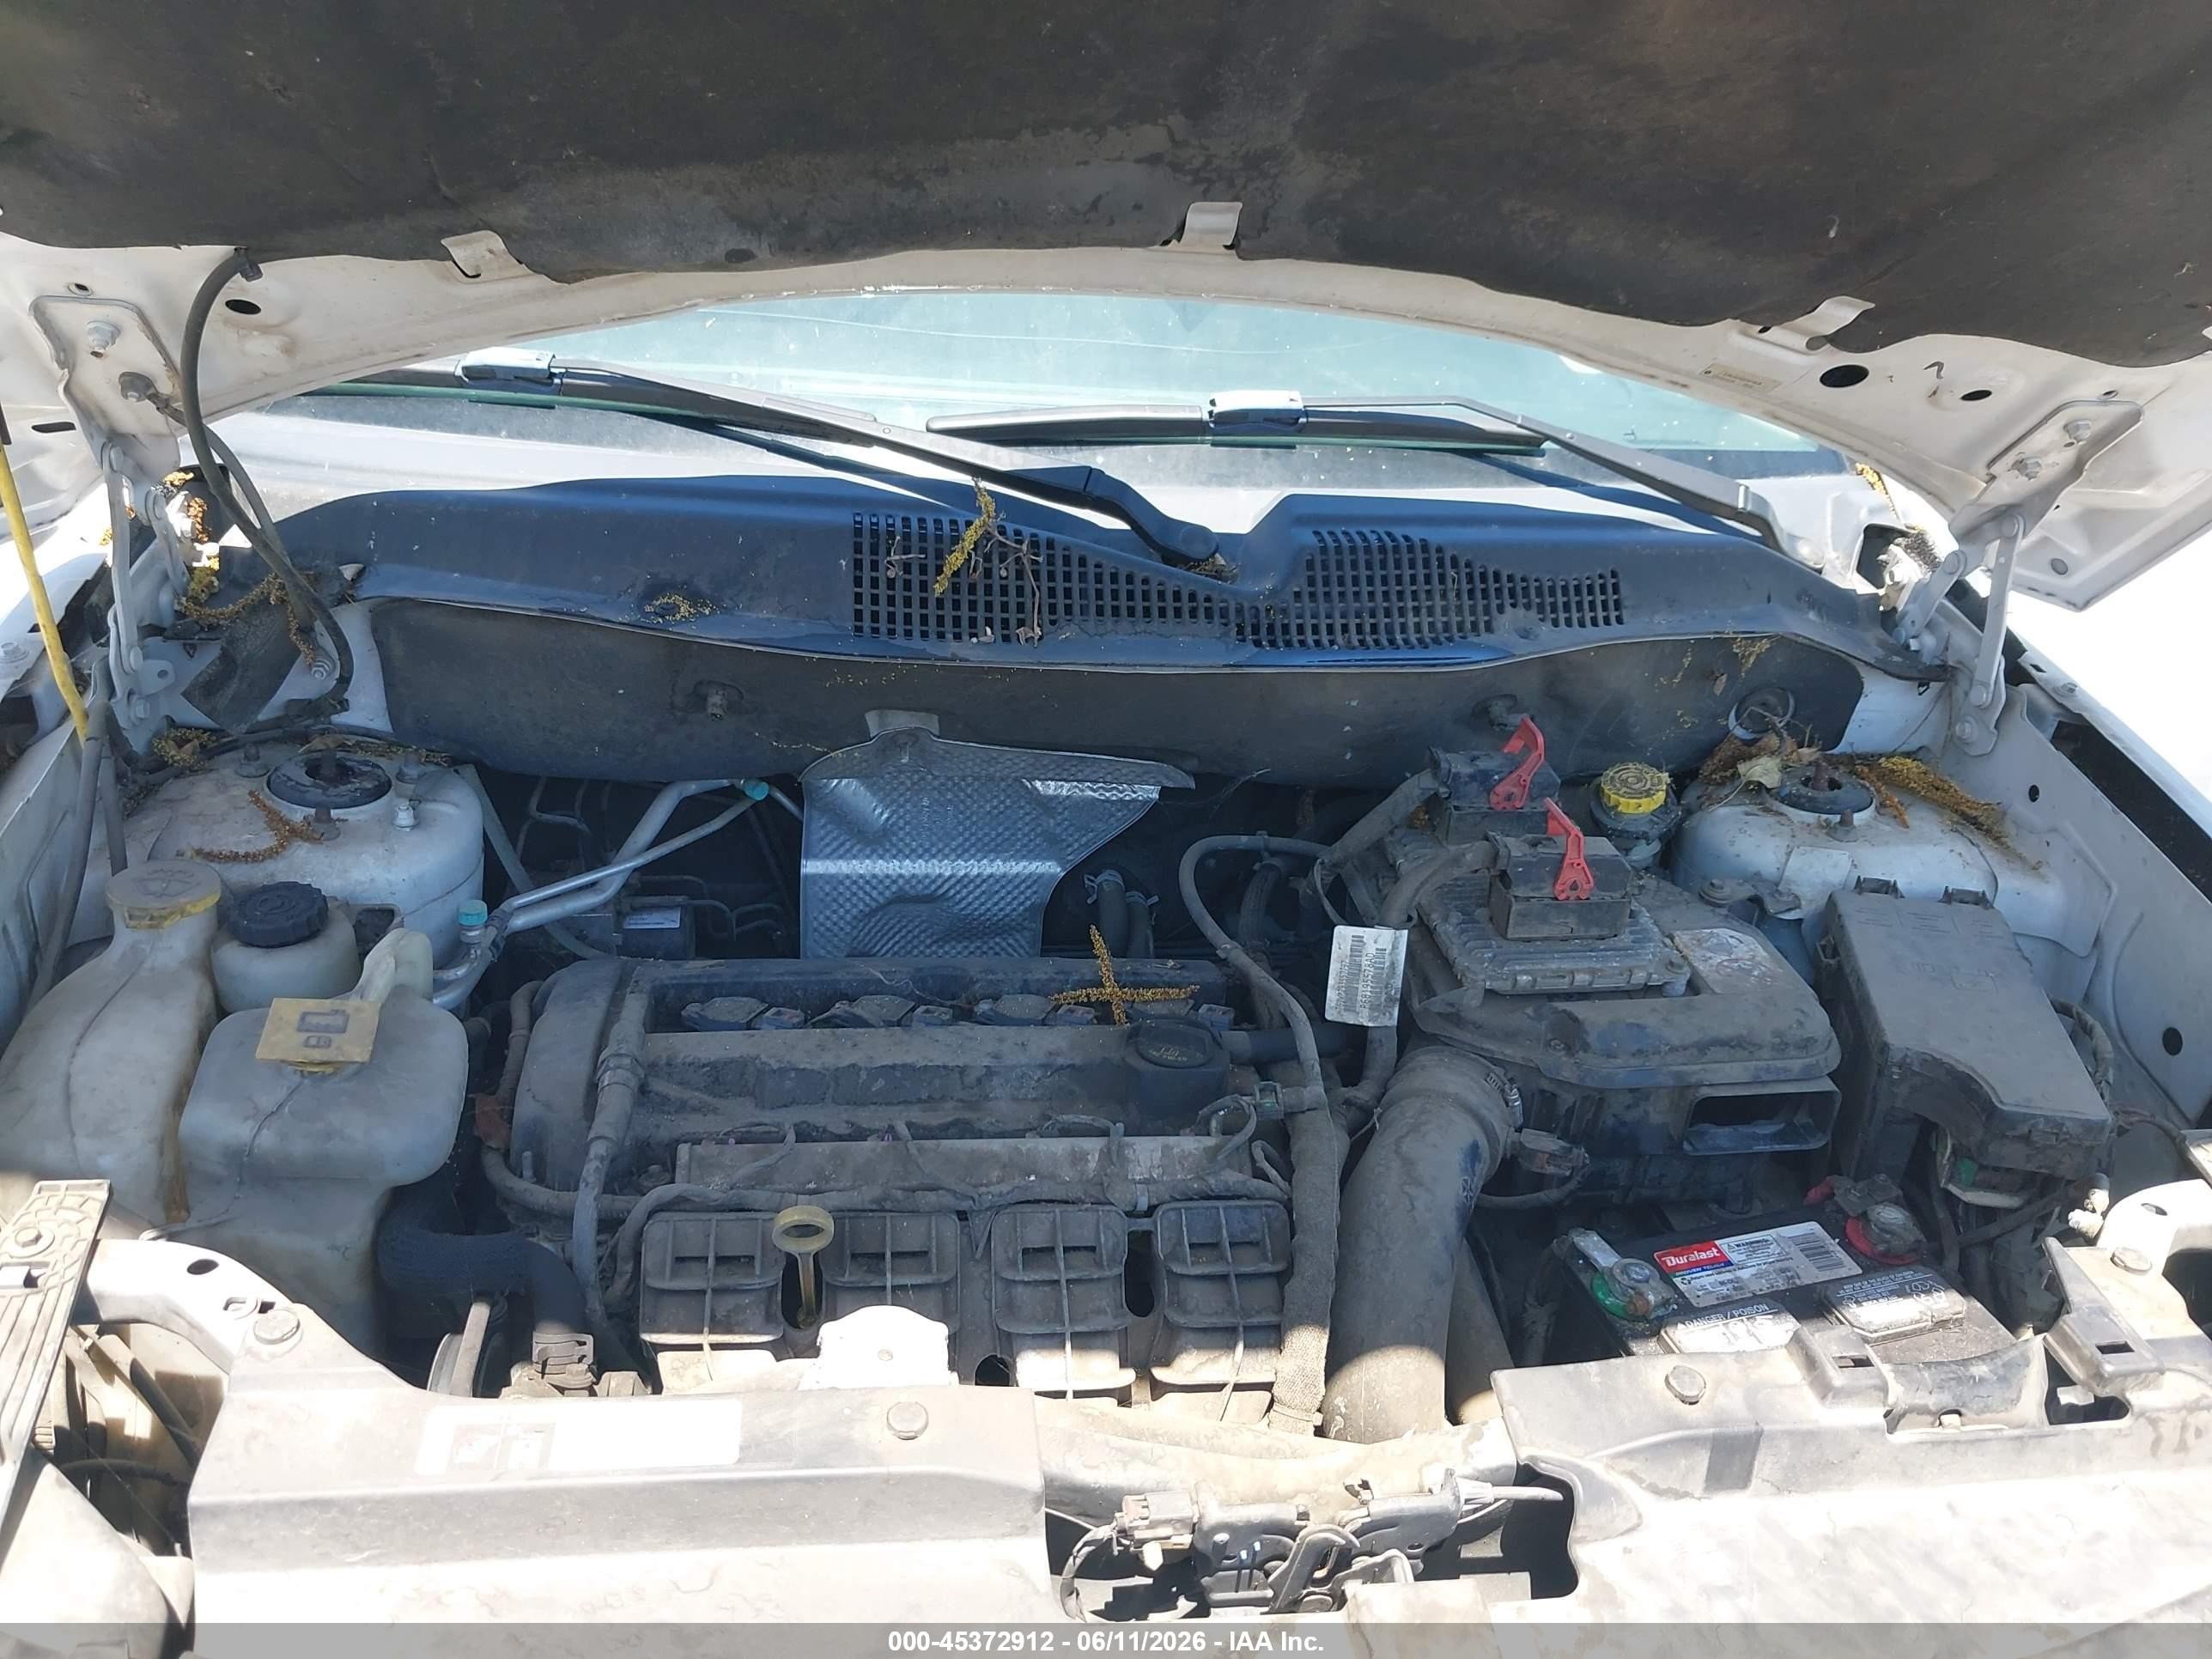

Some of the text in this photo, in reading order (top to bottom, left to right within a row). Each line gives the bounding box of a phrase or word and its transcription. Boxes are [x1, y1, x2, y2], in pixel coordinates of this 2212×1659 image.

[1359, 952, 1376, 1010] P68195578AD
[1662, 1247, 1720, 1267] Duralast
[1685, 1314, 1728, 1328] DANGER
[1732, 1304, 1770, 1317] POISON
